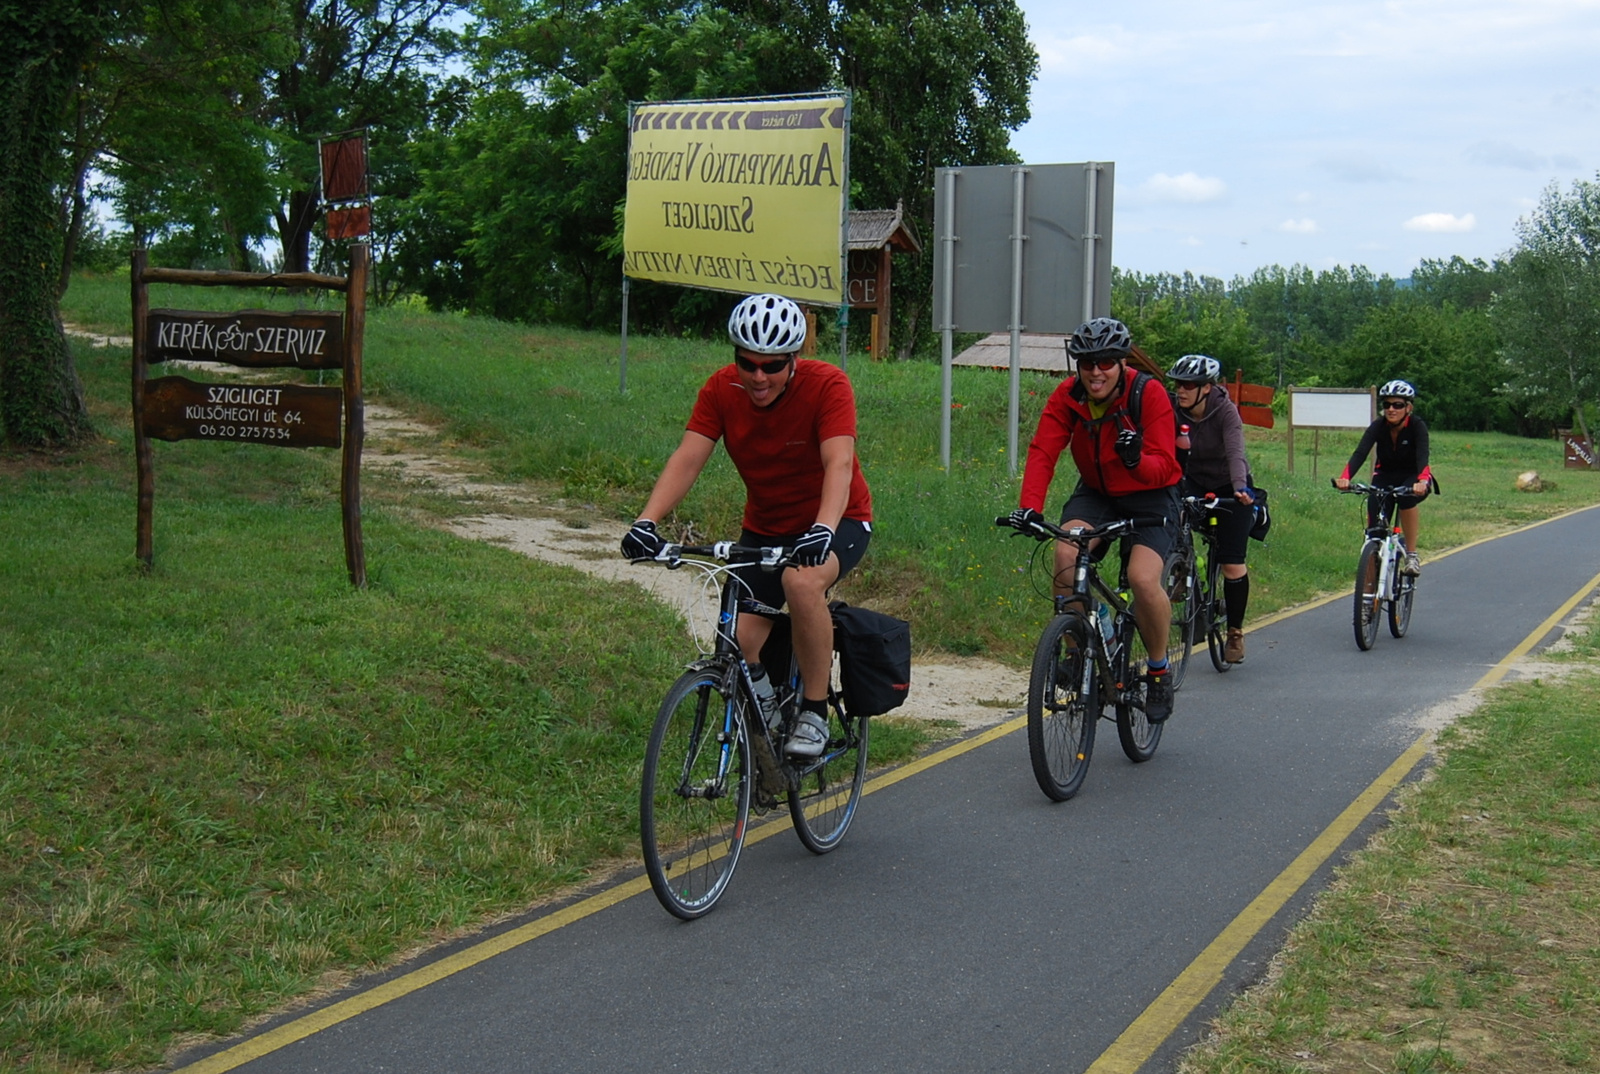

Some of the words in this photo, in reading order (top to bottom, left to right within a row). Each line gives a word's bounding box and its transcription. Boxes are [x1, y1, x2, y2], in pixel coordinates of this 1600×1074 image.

[208, 387, 282, 405] SZIGLIGET
[186, 405, 259, 422] KÜLSŐHEGYI
[264, 408, 277, 422] út
[284, 410, 305, 425] 64.
[200, 424, 216, 435] 06
[220, 425, 236, 436] 20
